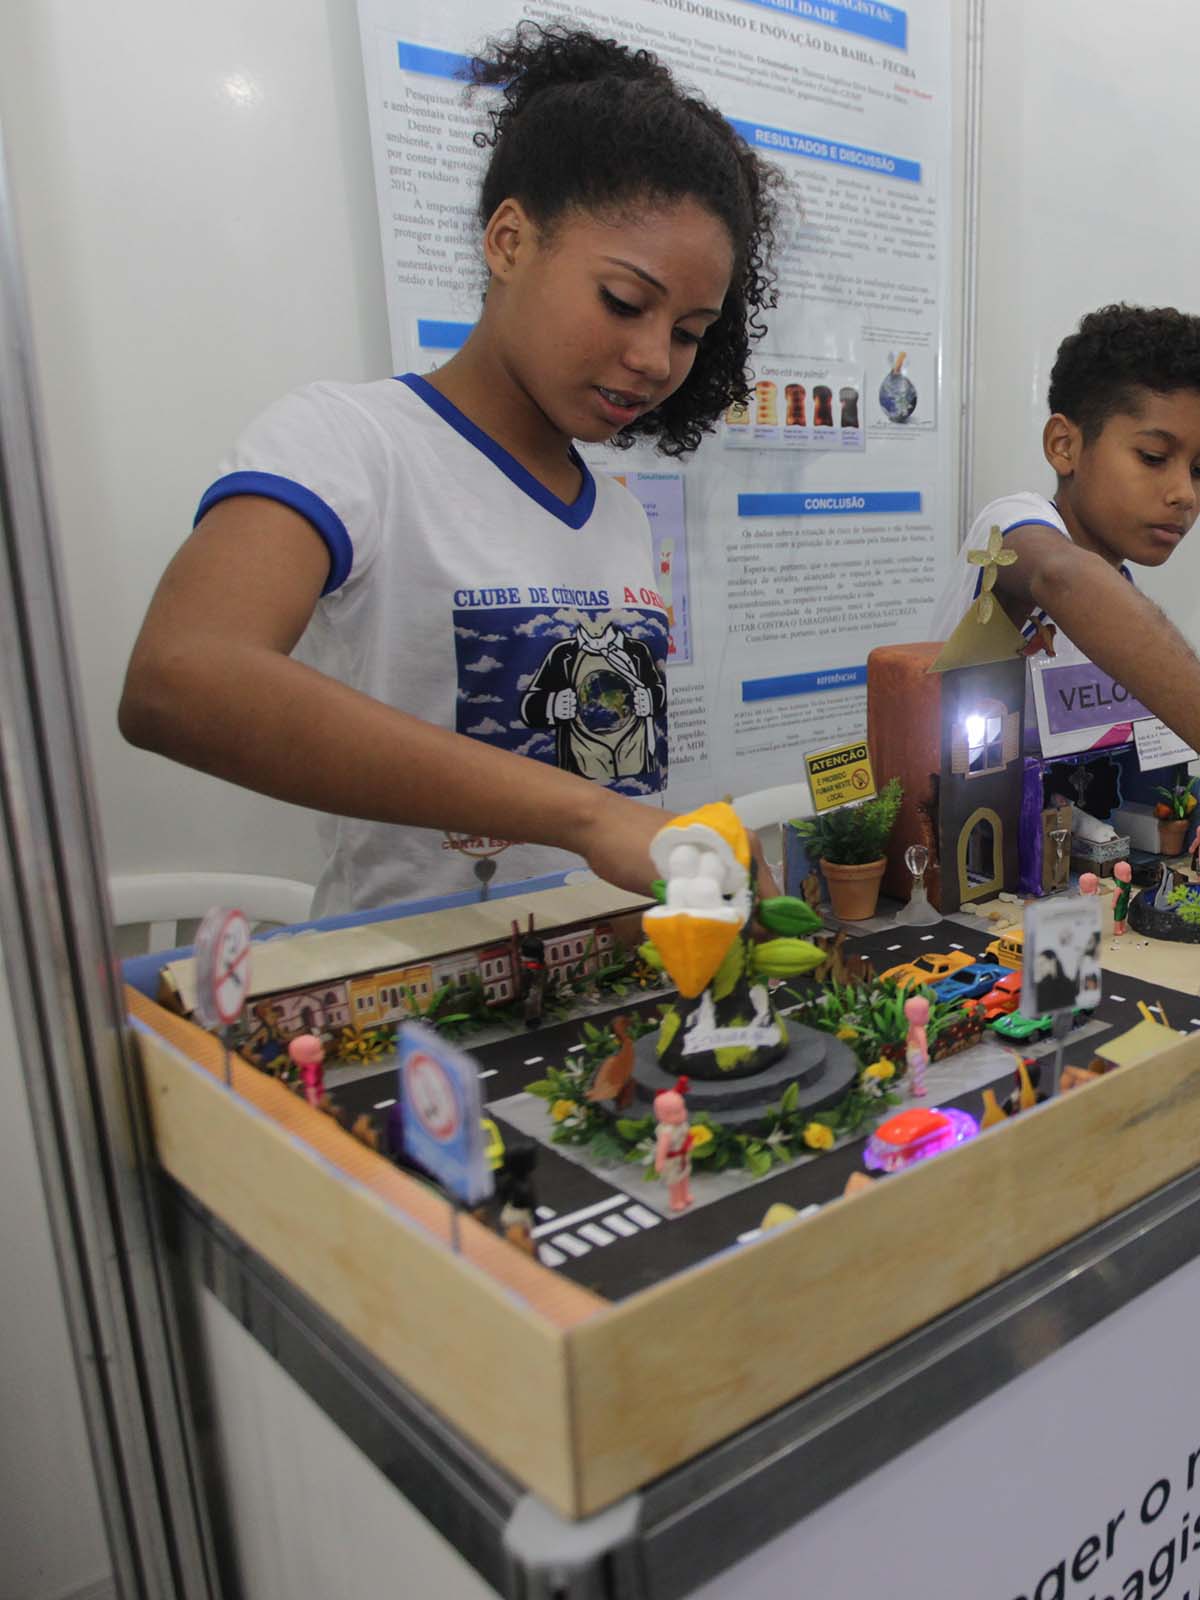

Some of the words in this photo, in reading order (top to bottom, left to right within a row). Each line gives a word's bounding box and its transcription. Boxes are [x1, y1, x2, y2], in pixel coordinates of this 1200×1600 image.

[755, 128, 829, 157] RESULTADOS
[829, 145, 837, 159] E
[838, 147, 896, 173] DISCUSSÃO
[804, 496, 865, 511] CONCLUSÃO
[453, 587, 521, 608] CLUBE
[528, 586, 548, 605] DE
[623, 586, 638, 604] A
[1059, 682, 1135, 711] VELO
[811, 748, 866, 772] ATENÇÃO
[1010, 1510, 1125, 1600] ger
[1140, 1479, 1170, 1525] o
